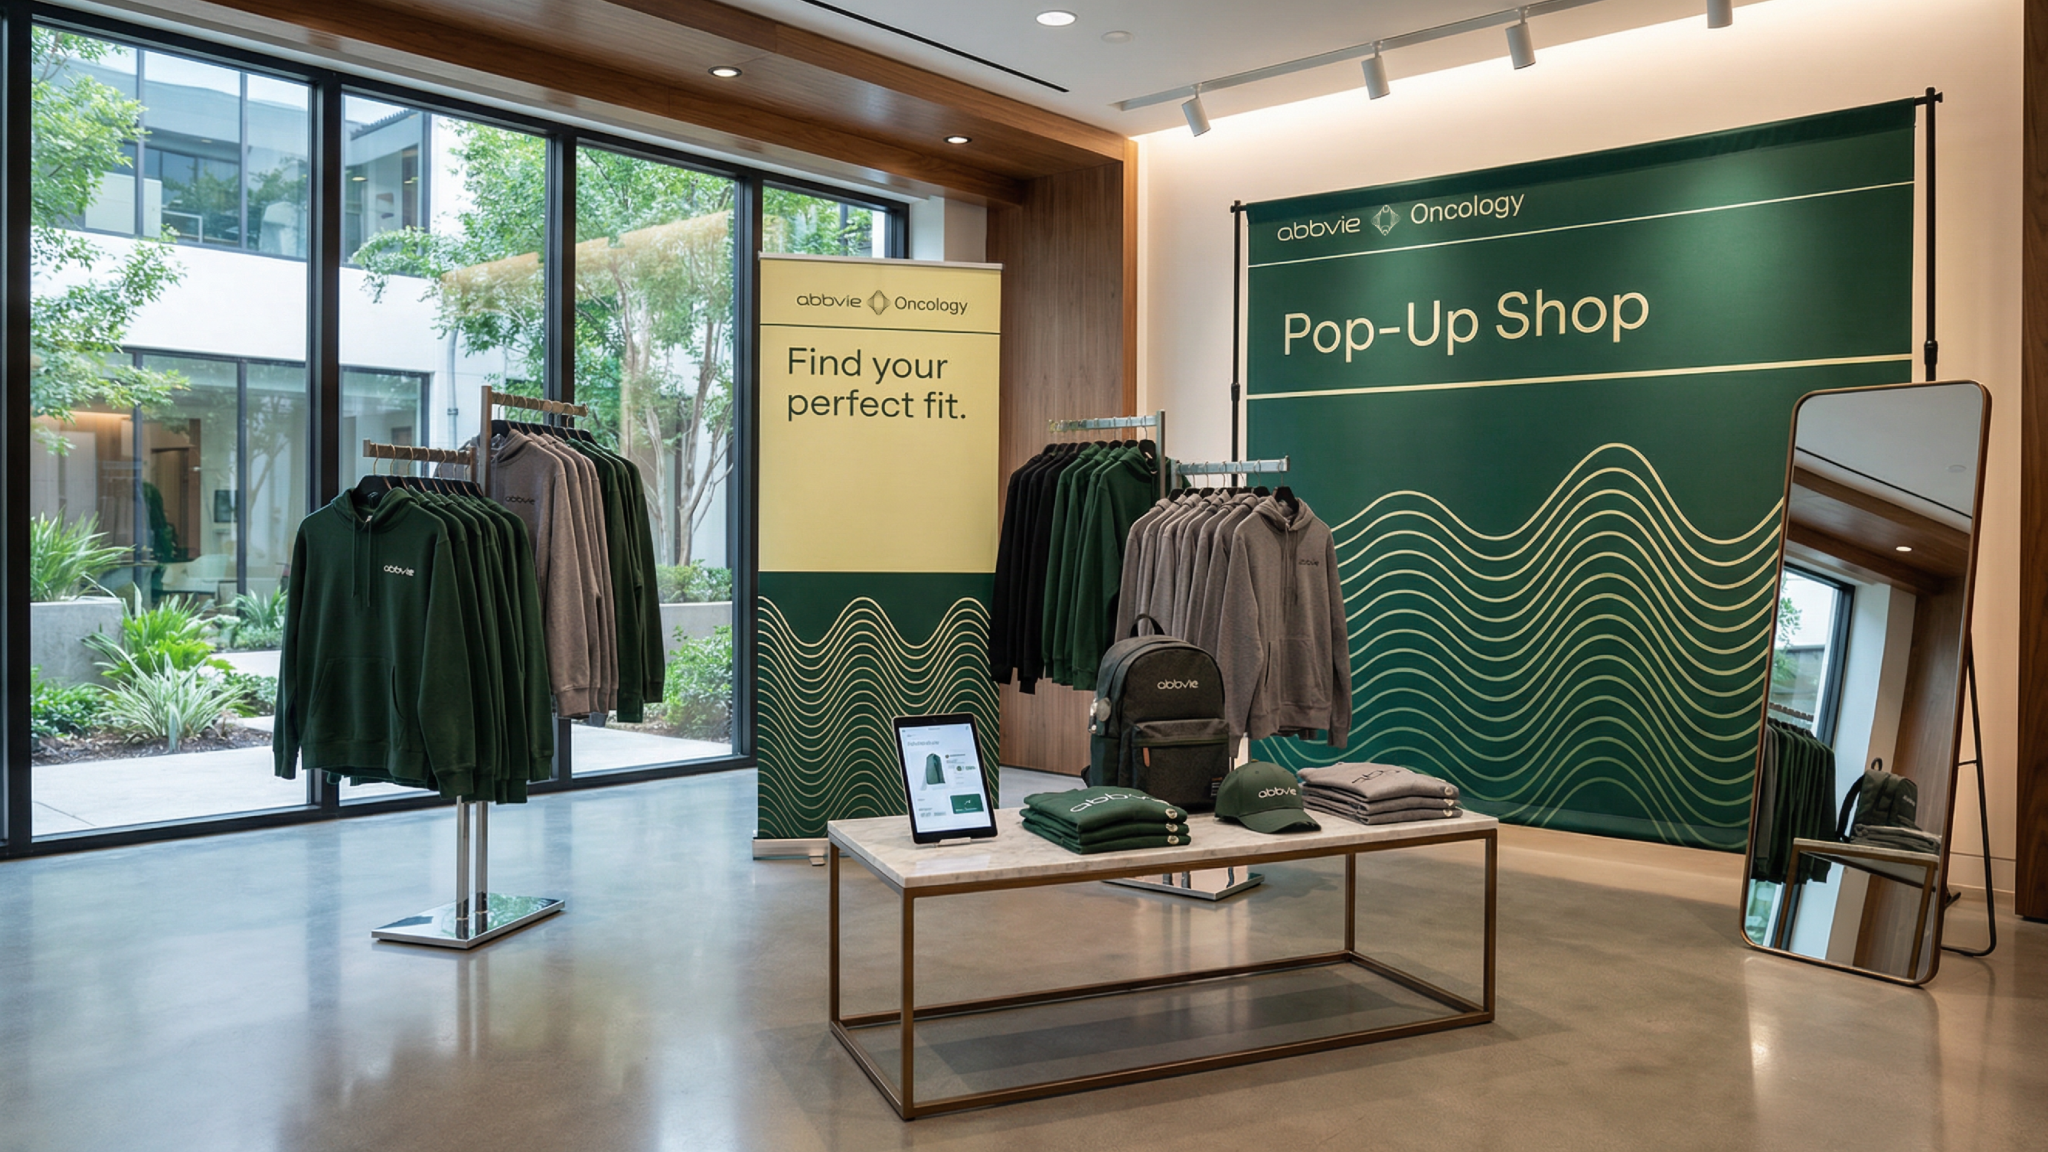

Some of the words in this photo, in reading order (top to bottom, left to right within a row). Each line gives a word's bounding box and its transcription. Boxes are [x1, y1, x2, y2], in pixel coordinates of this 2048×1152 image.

[1277, 215, 1361, 242] abbvie
[1410, 193, 1525, 225] Oncology
[796, 293, 862, 308] abbvie
[894, 295, 968, 315] Oncology
[1284, 299, 1479, 363] Pop-Up
[1496, 289, 1650, 343] Shop
[788, 347, 861, 377] Find
[872, 358, 948, 385] your
[788, 389, 915, 422] perfect
[923, 391, 966, 420] fit.
[1156, 678, 1199, 690] abbvie
